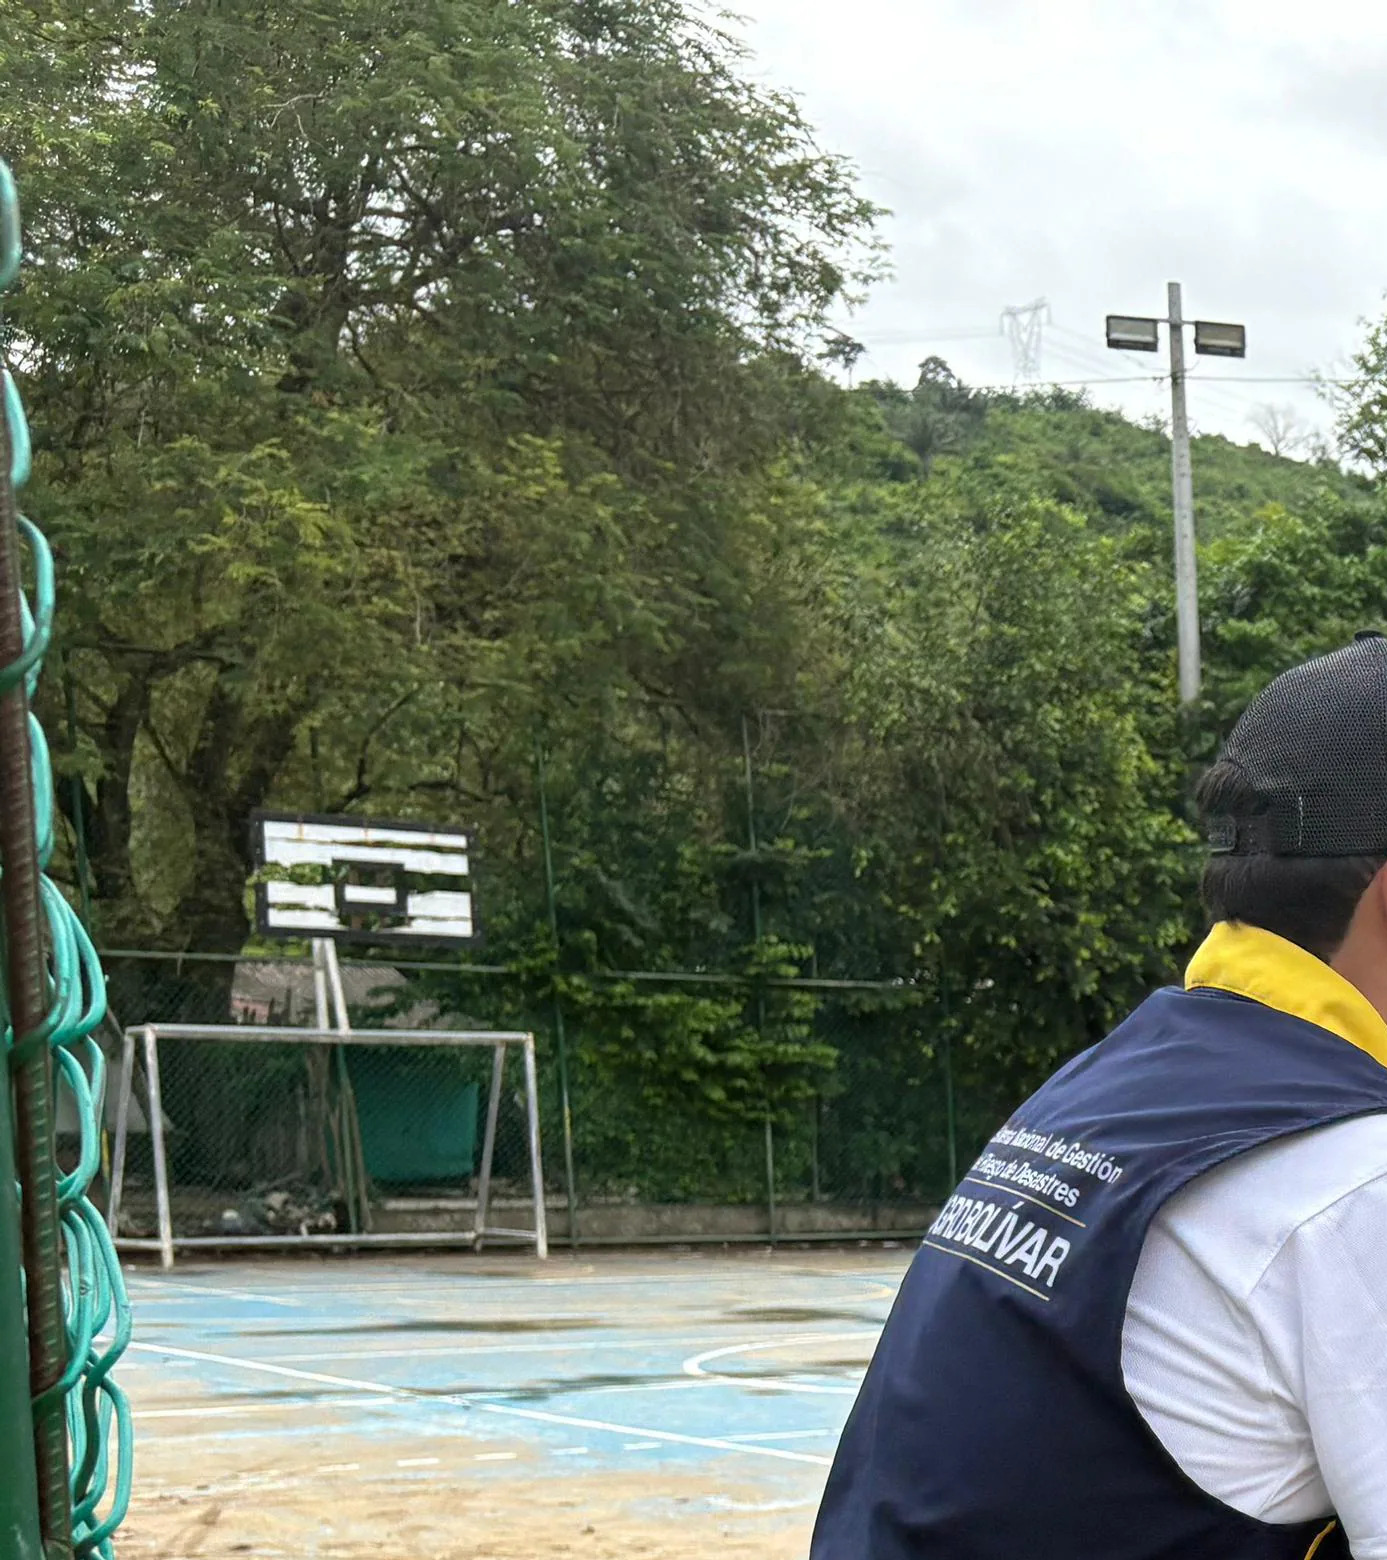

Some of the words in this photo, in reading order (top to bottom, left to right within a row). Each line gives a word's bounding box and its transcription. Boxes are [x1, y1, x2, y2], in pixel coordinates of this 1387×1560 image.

[1045, 1137, 1067, 1160] de
[1062, 1142, 1123, 1184] Gestión
[1011, 1162, 1080, 1208] Desastres
[928, 1194, 1071, 1288] GRDBOLÍVAR
